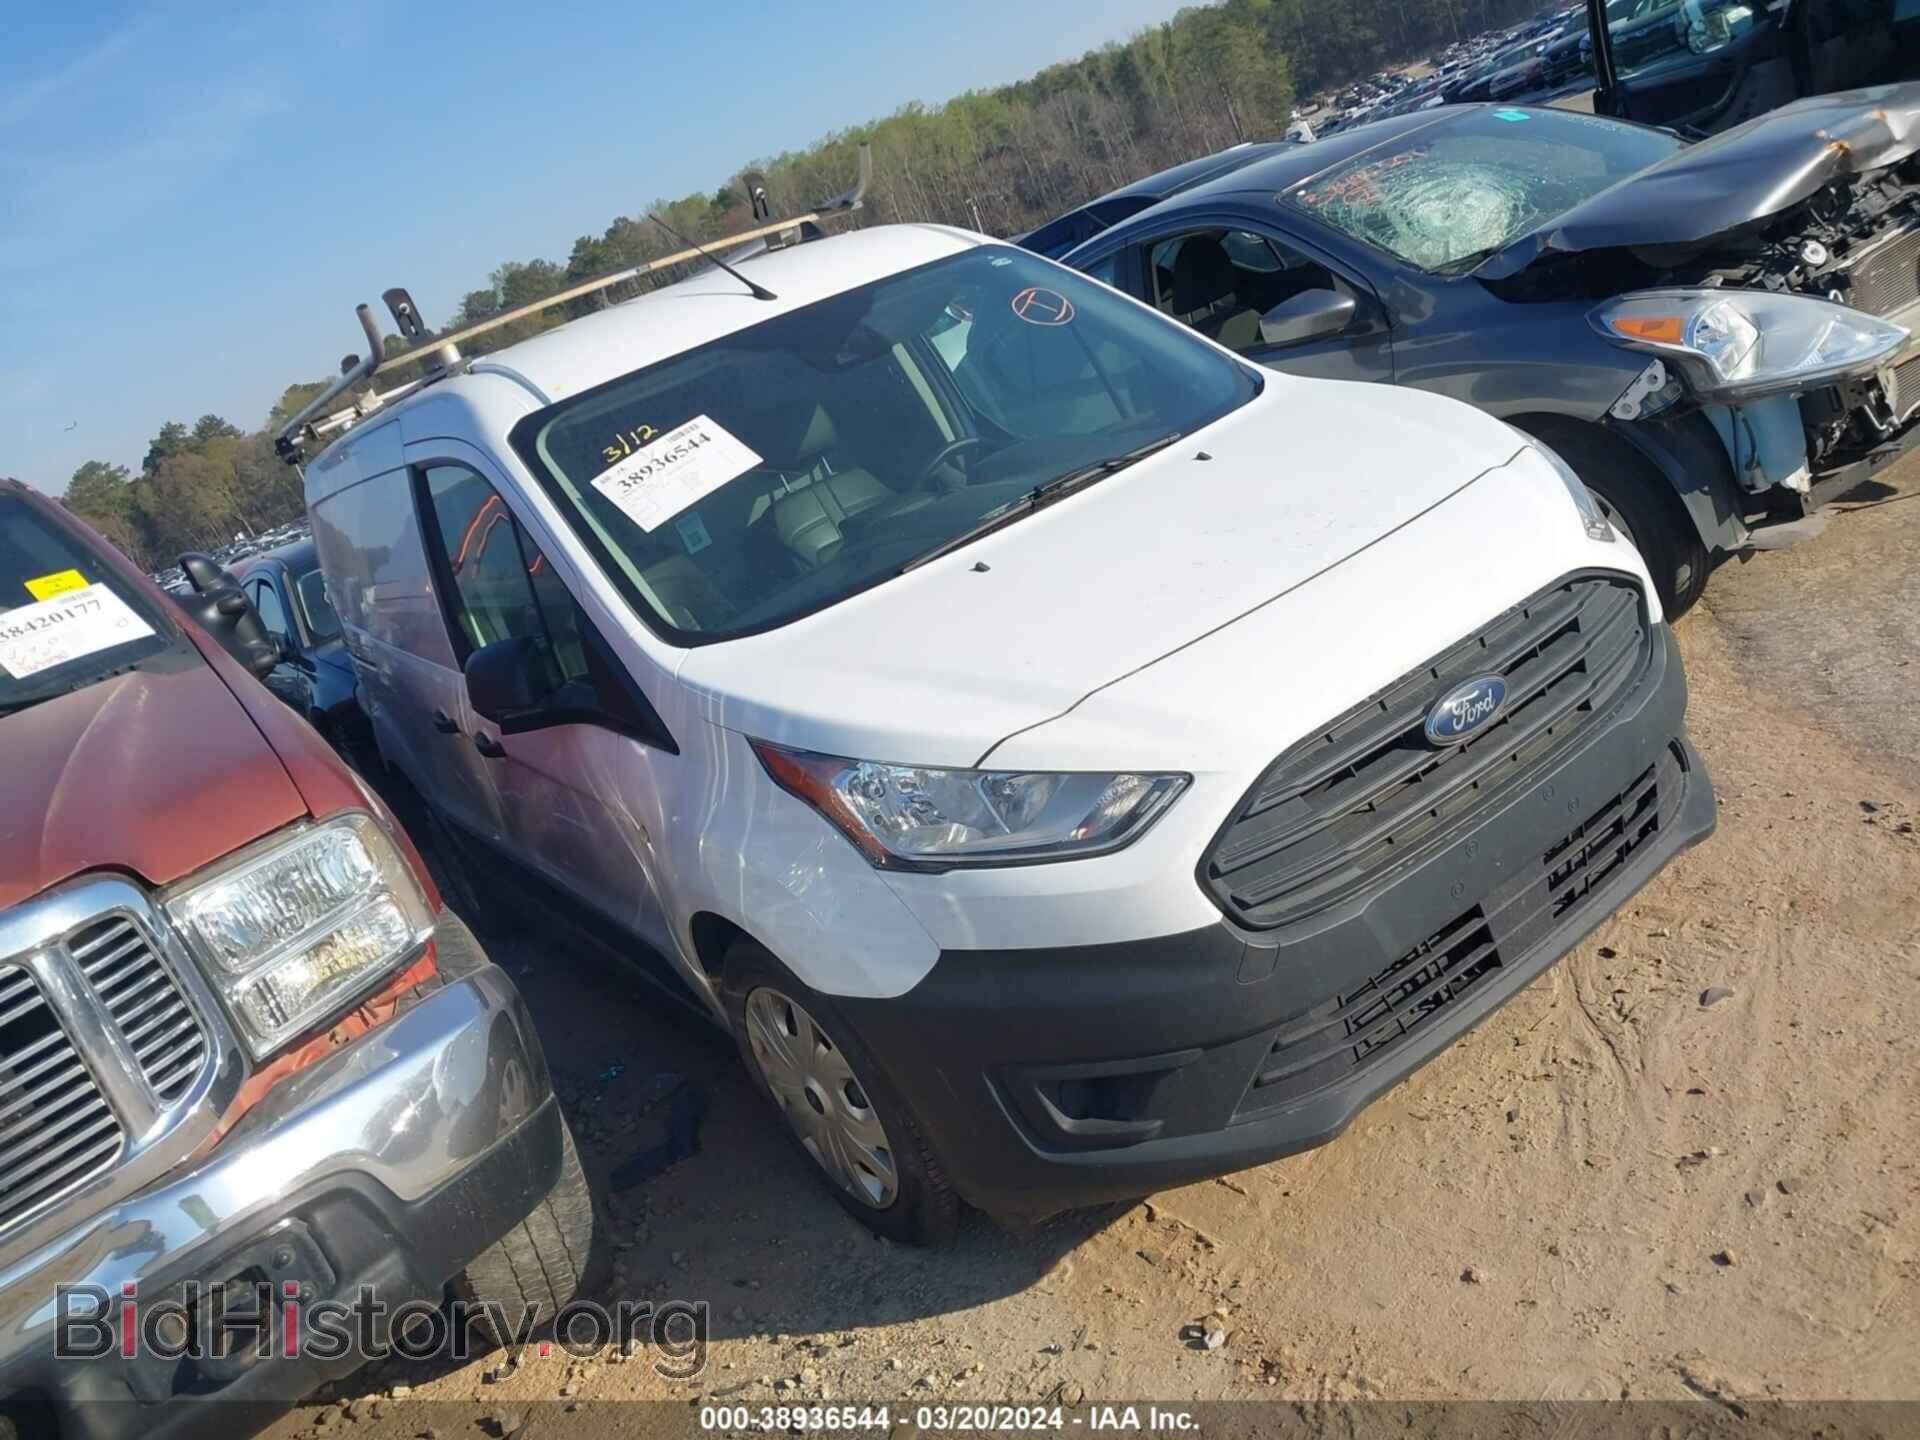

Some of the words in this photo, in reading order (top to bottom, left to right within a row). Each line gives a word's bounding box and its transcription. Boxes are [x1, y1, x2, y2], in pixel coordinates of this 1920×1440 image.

[601, 424, 659, 463] 3/12
[617, 432, 712, 494] 38936544
[1452, 687, 1496, 731] Ford
